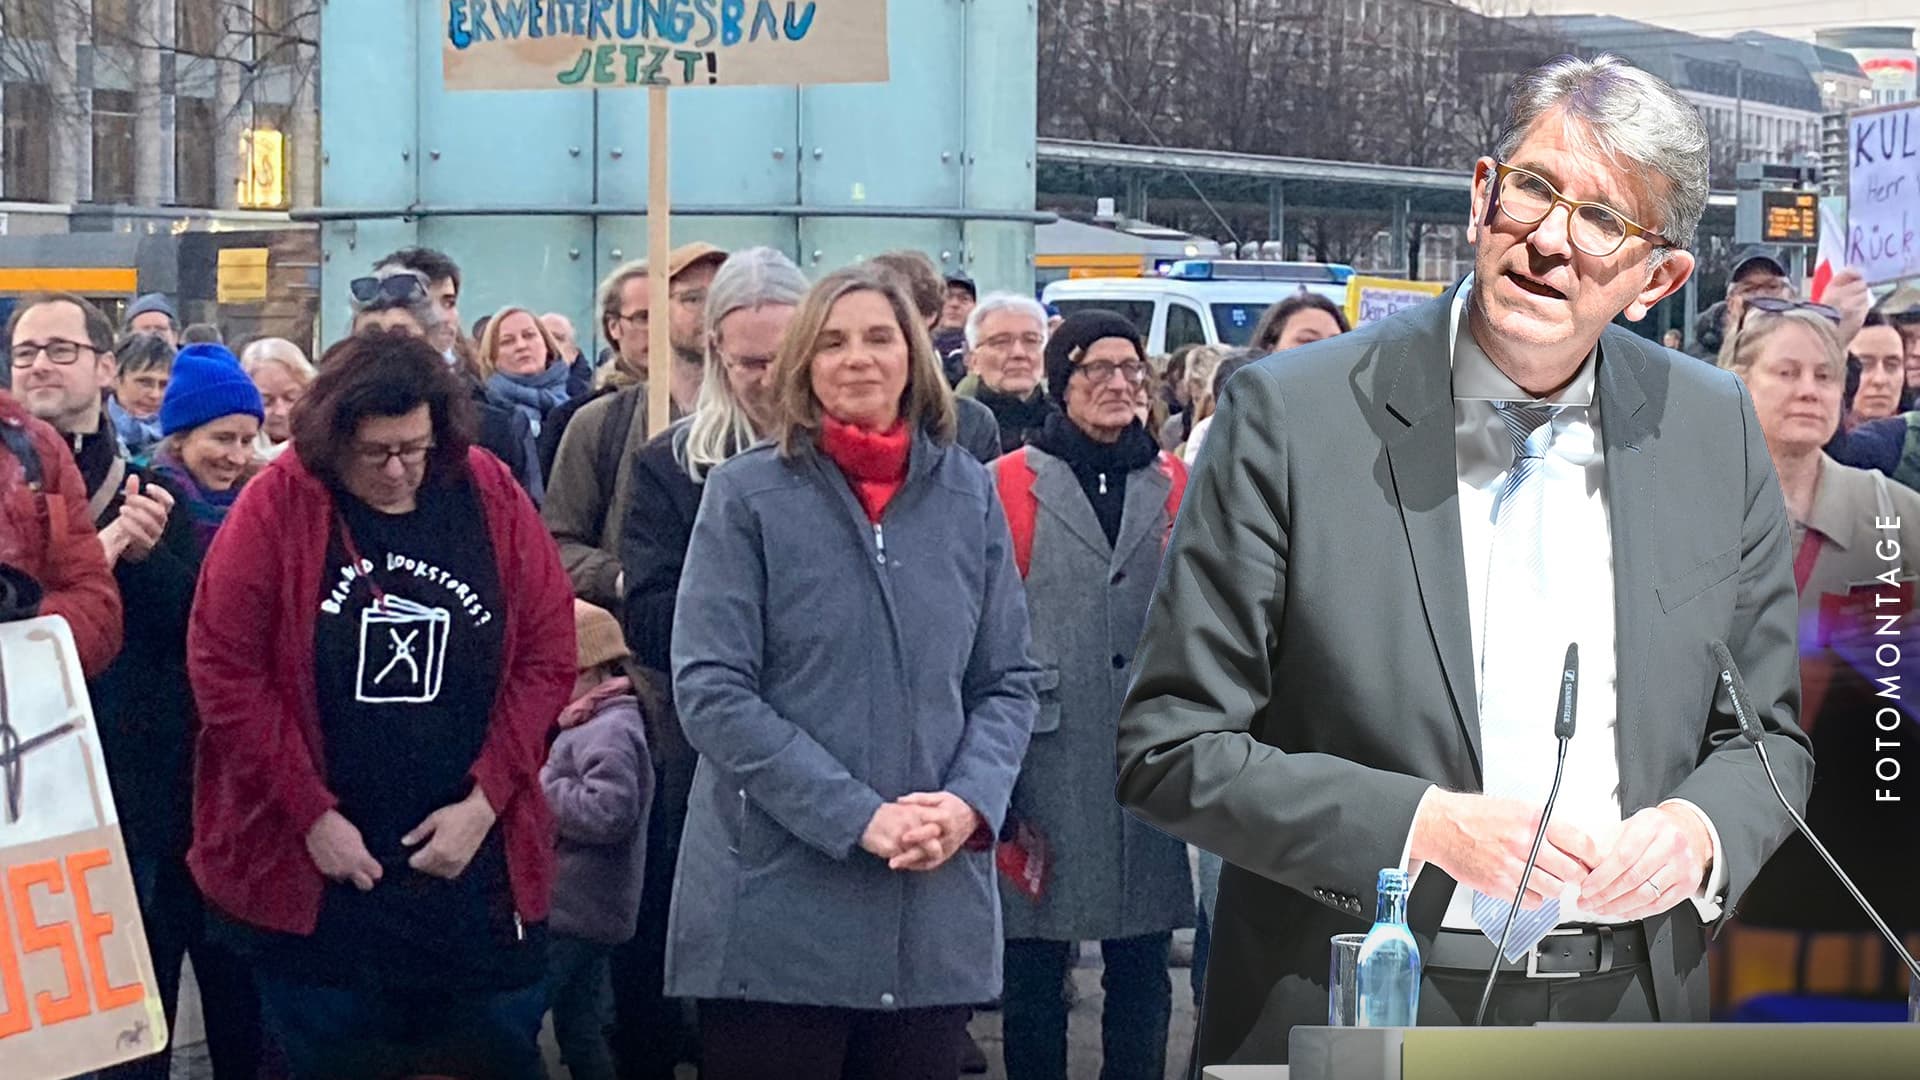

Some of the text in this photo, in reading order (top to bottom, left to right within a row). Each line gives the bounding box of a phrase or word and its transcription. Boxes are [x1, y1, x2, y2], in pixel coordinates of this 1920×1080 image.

[449, 0, 816, 49] ERWEITERUNGSBAU
[557, 44, 718, 85] JETZT!
[1855, 112, 1917, 168] KUL
[1728, 685, 1749, 731] SENNHEISER
